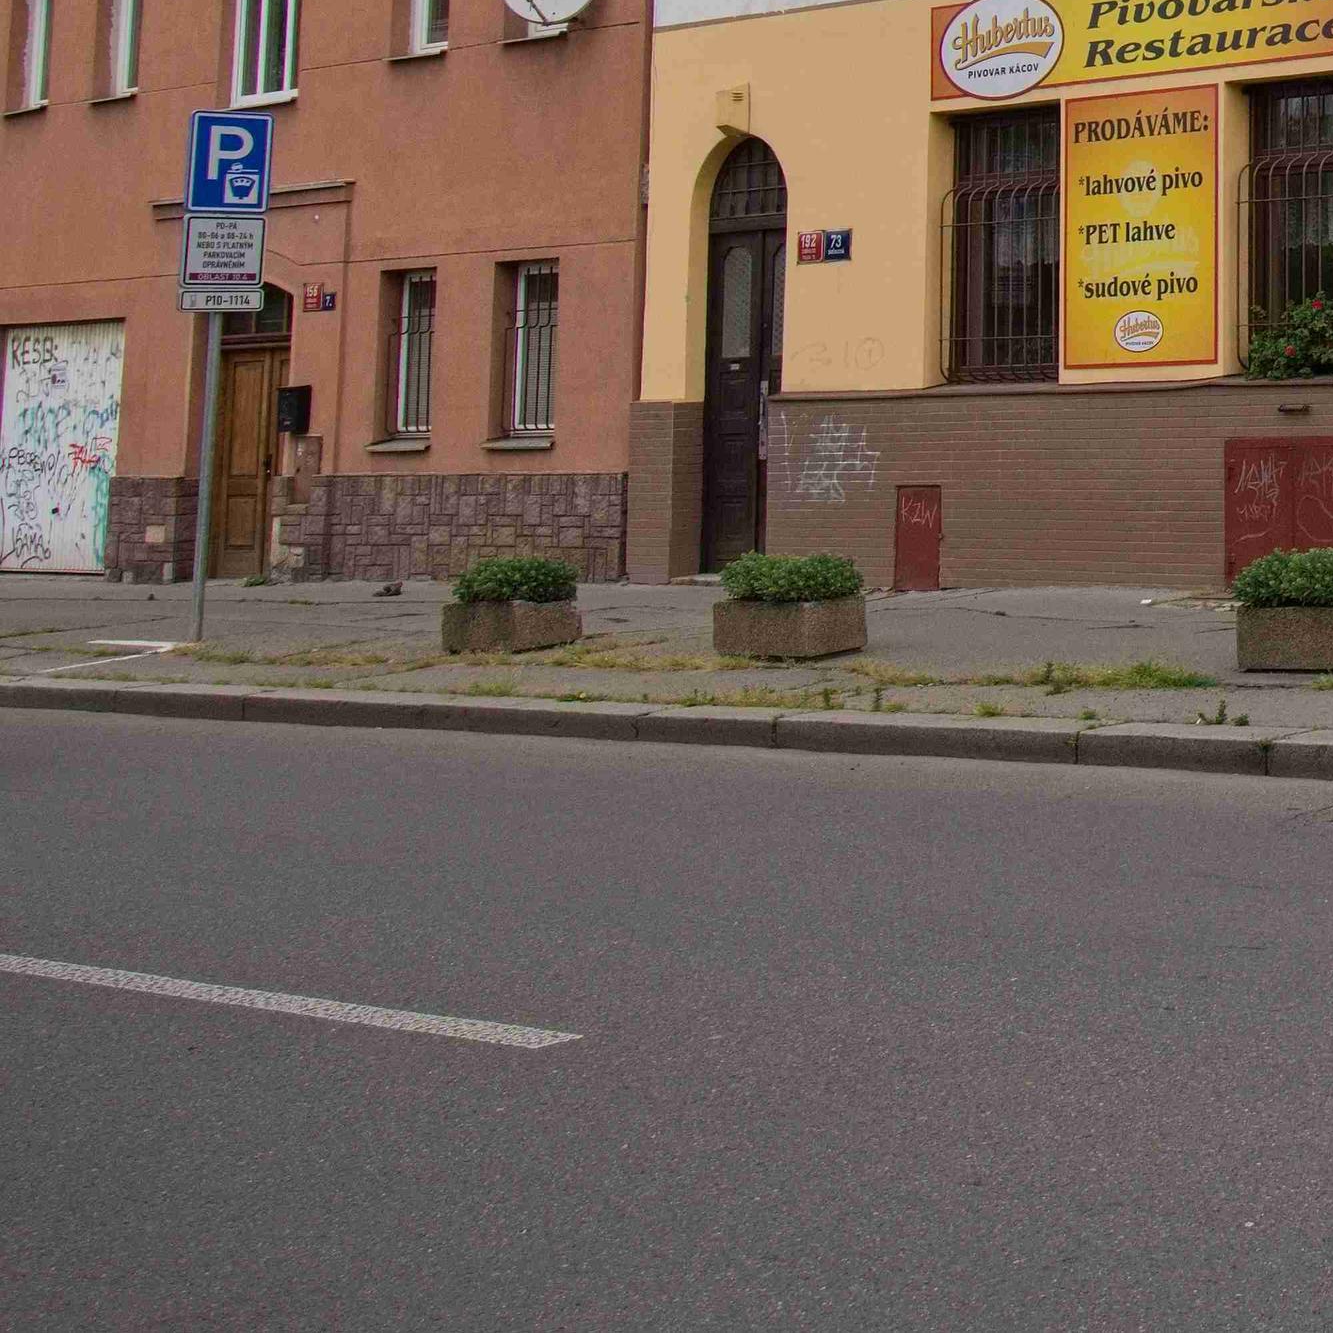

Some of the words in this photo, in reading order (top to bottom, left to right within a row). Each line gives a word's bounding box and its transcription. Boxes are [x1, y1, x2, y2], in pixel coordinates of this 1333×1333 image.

[952, 7, 1055, 64] Hubertus
[968, 67, 1006, 79] PIVOVAR
[1008, 63, 1039, 75] KÁCOV
[1073, 107, 1210, 144] PRODÁVÁME:
[207, 125, 254, 180] P
[1160, 165, 1204, 197] pivo
[800, 234, 817, 248] 192
[830, 234, 842, 248] 73
[1124, 220, 1176, 243] lahve
[1156, 270, 1199, 301] pivo
[205, 295, 250, 306] P10-1114
